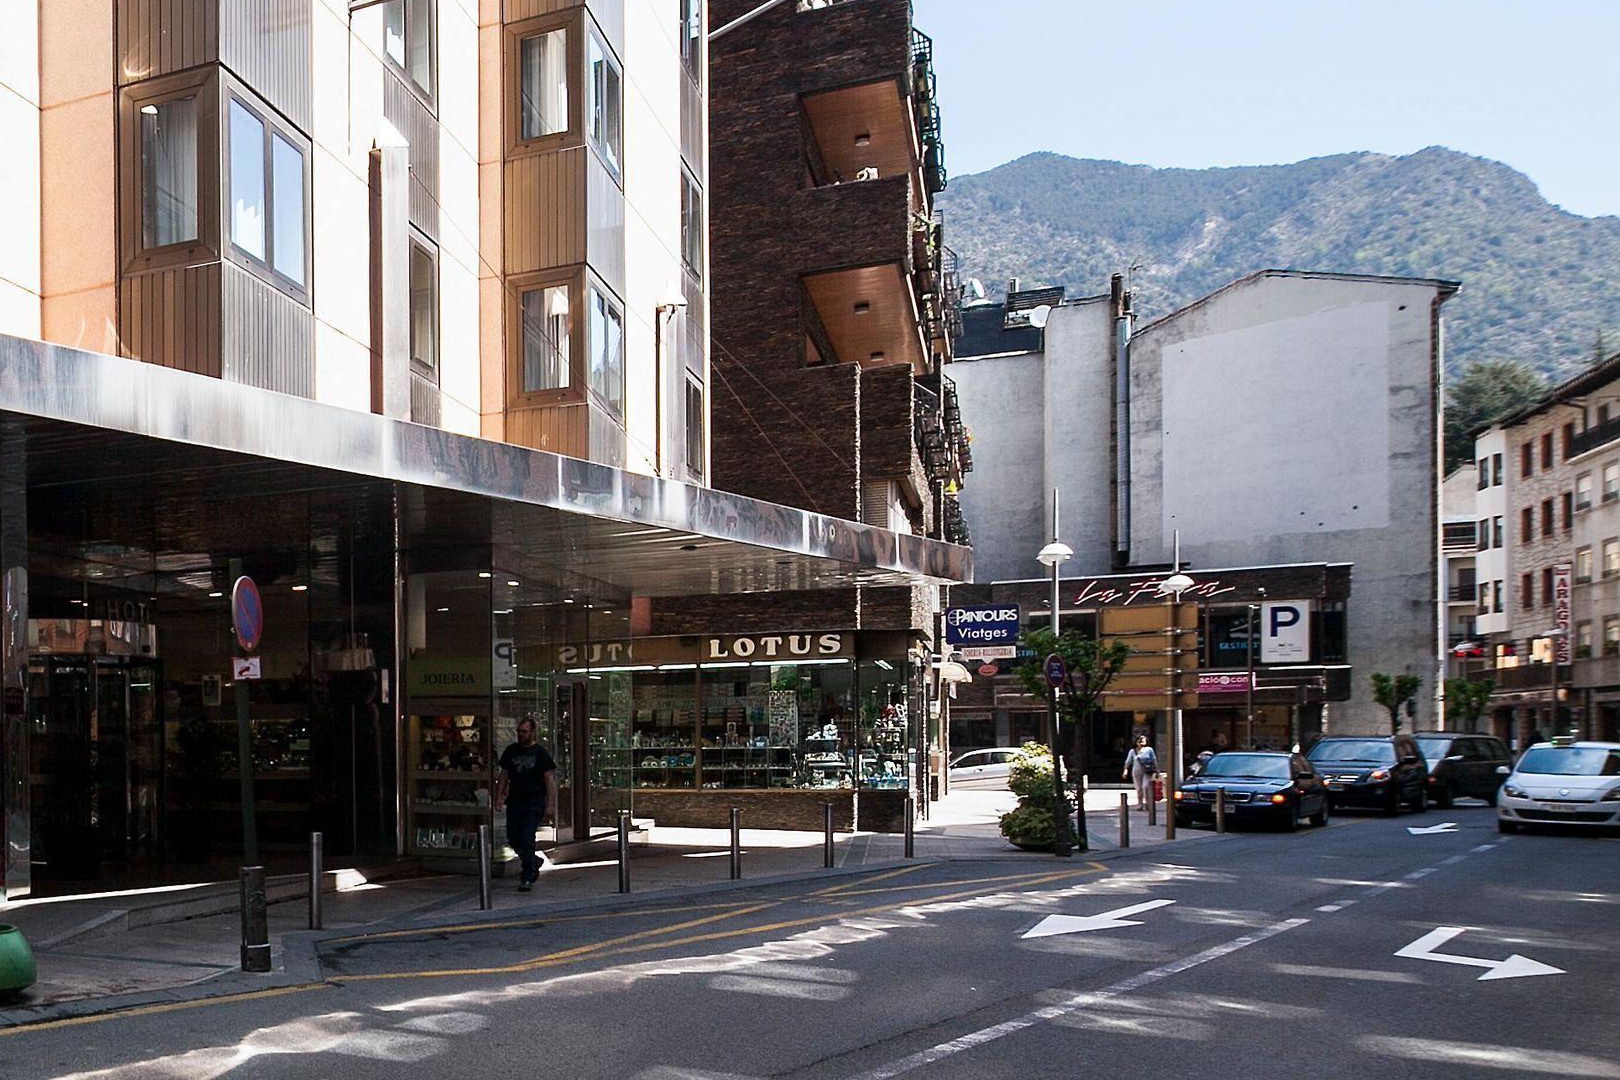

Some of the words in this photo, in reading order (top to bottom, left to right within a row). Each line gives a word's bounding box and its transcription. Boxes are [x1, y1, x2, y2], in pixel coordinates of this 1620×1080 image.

[956, 609, 1017, 625] PANTOURS
[1270, 606, 1300, 637] P
[958, 628, 1007, 640] Viatges
[709, 634, 841, 658] LOTUS
[422, 672, 475, 685] JOIERIA
